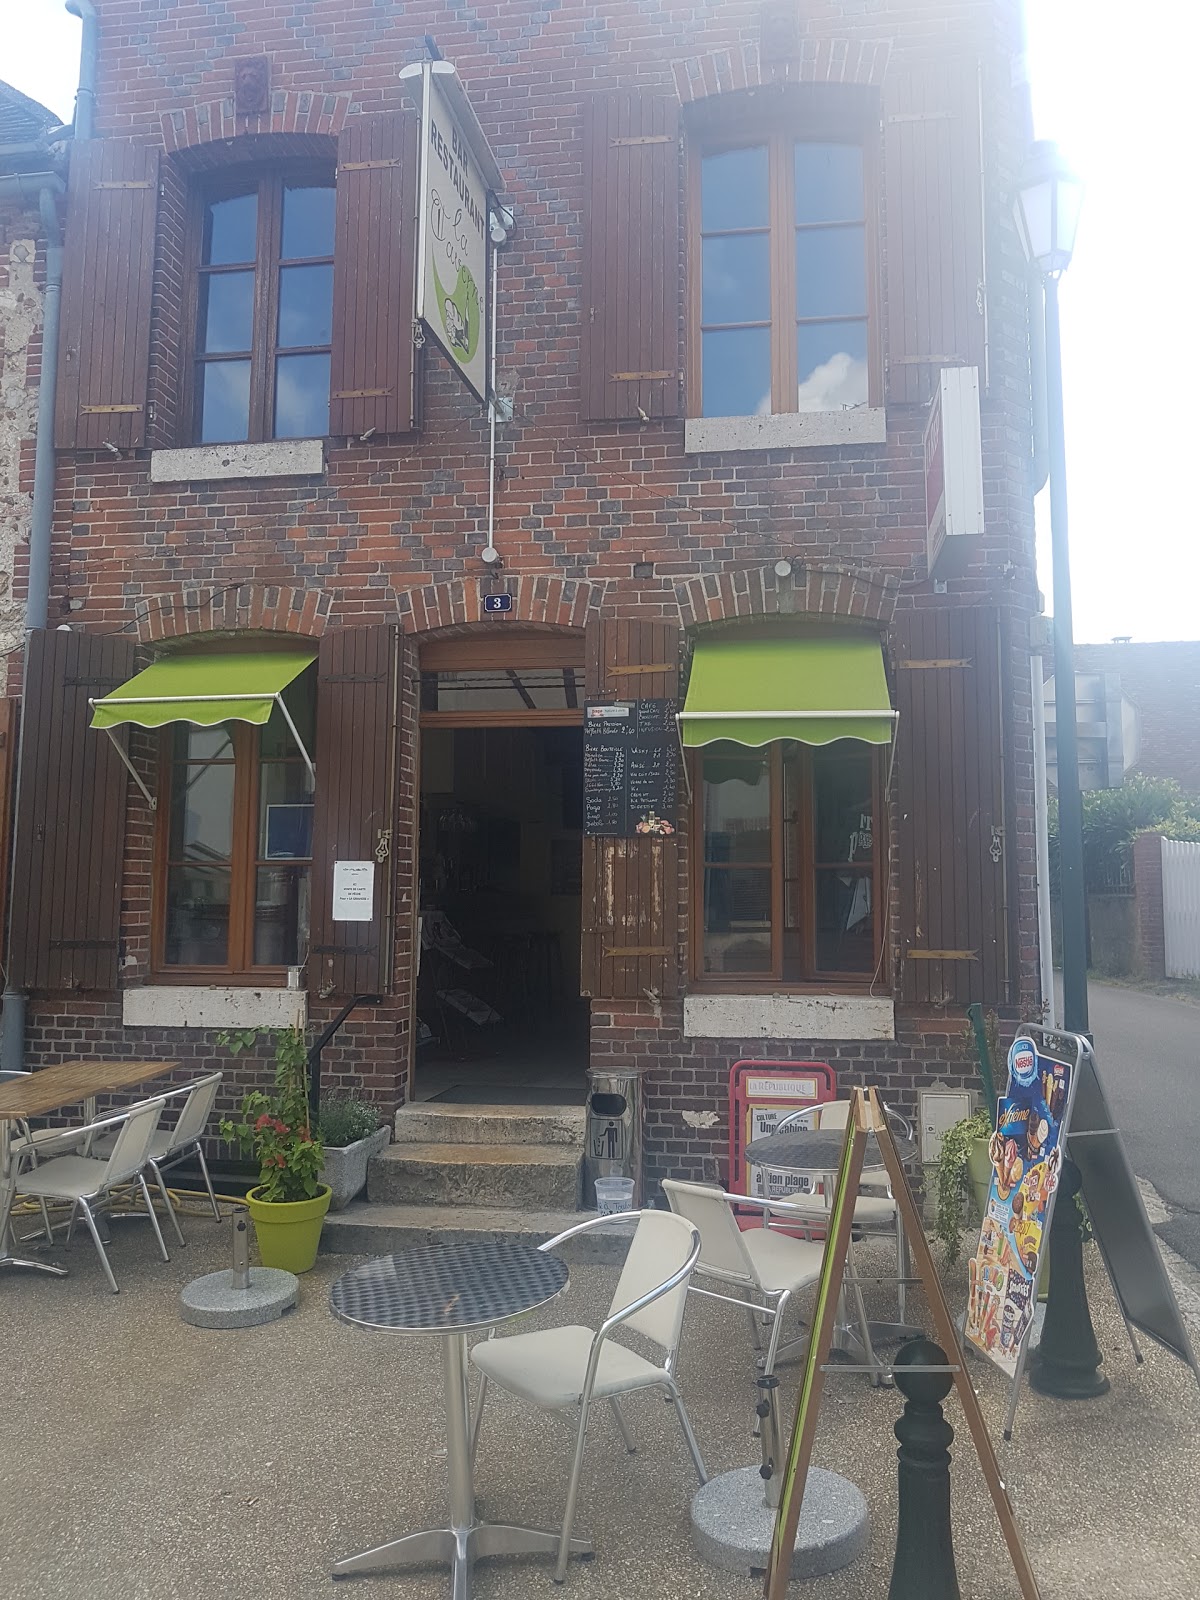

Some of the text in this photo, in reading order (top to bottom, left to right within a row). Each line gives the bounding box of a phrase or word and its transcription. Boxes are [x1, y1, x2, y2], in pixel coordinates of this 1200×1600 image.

[452, 126, 468, 178] BAR
[431, 119, 485, 238] RESTAURANT
[494, 598, 501, 608] 3
[1016, 1056, 1032, 1068] Nestlé
[756, 1113, 777, 1121] CULTURE
[785, 1174, 809, 1188] plage
